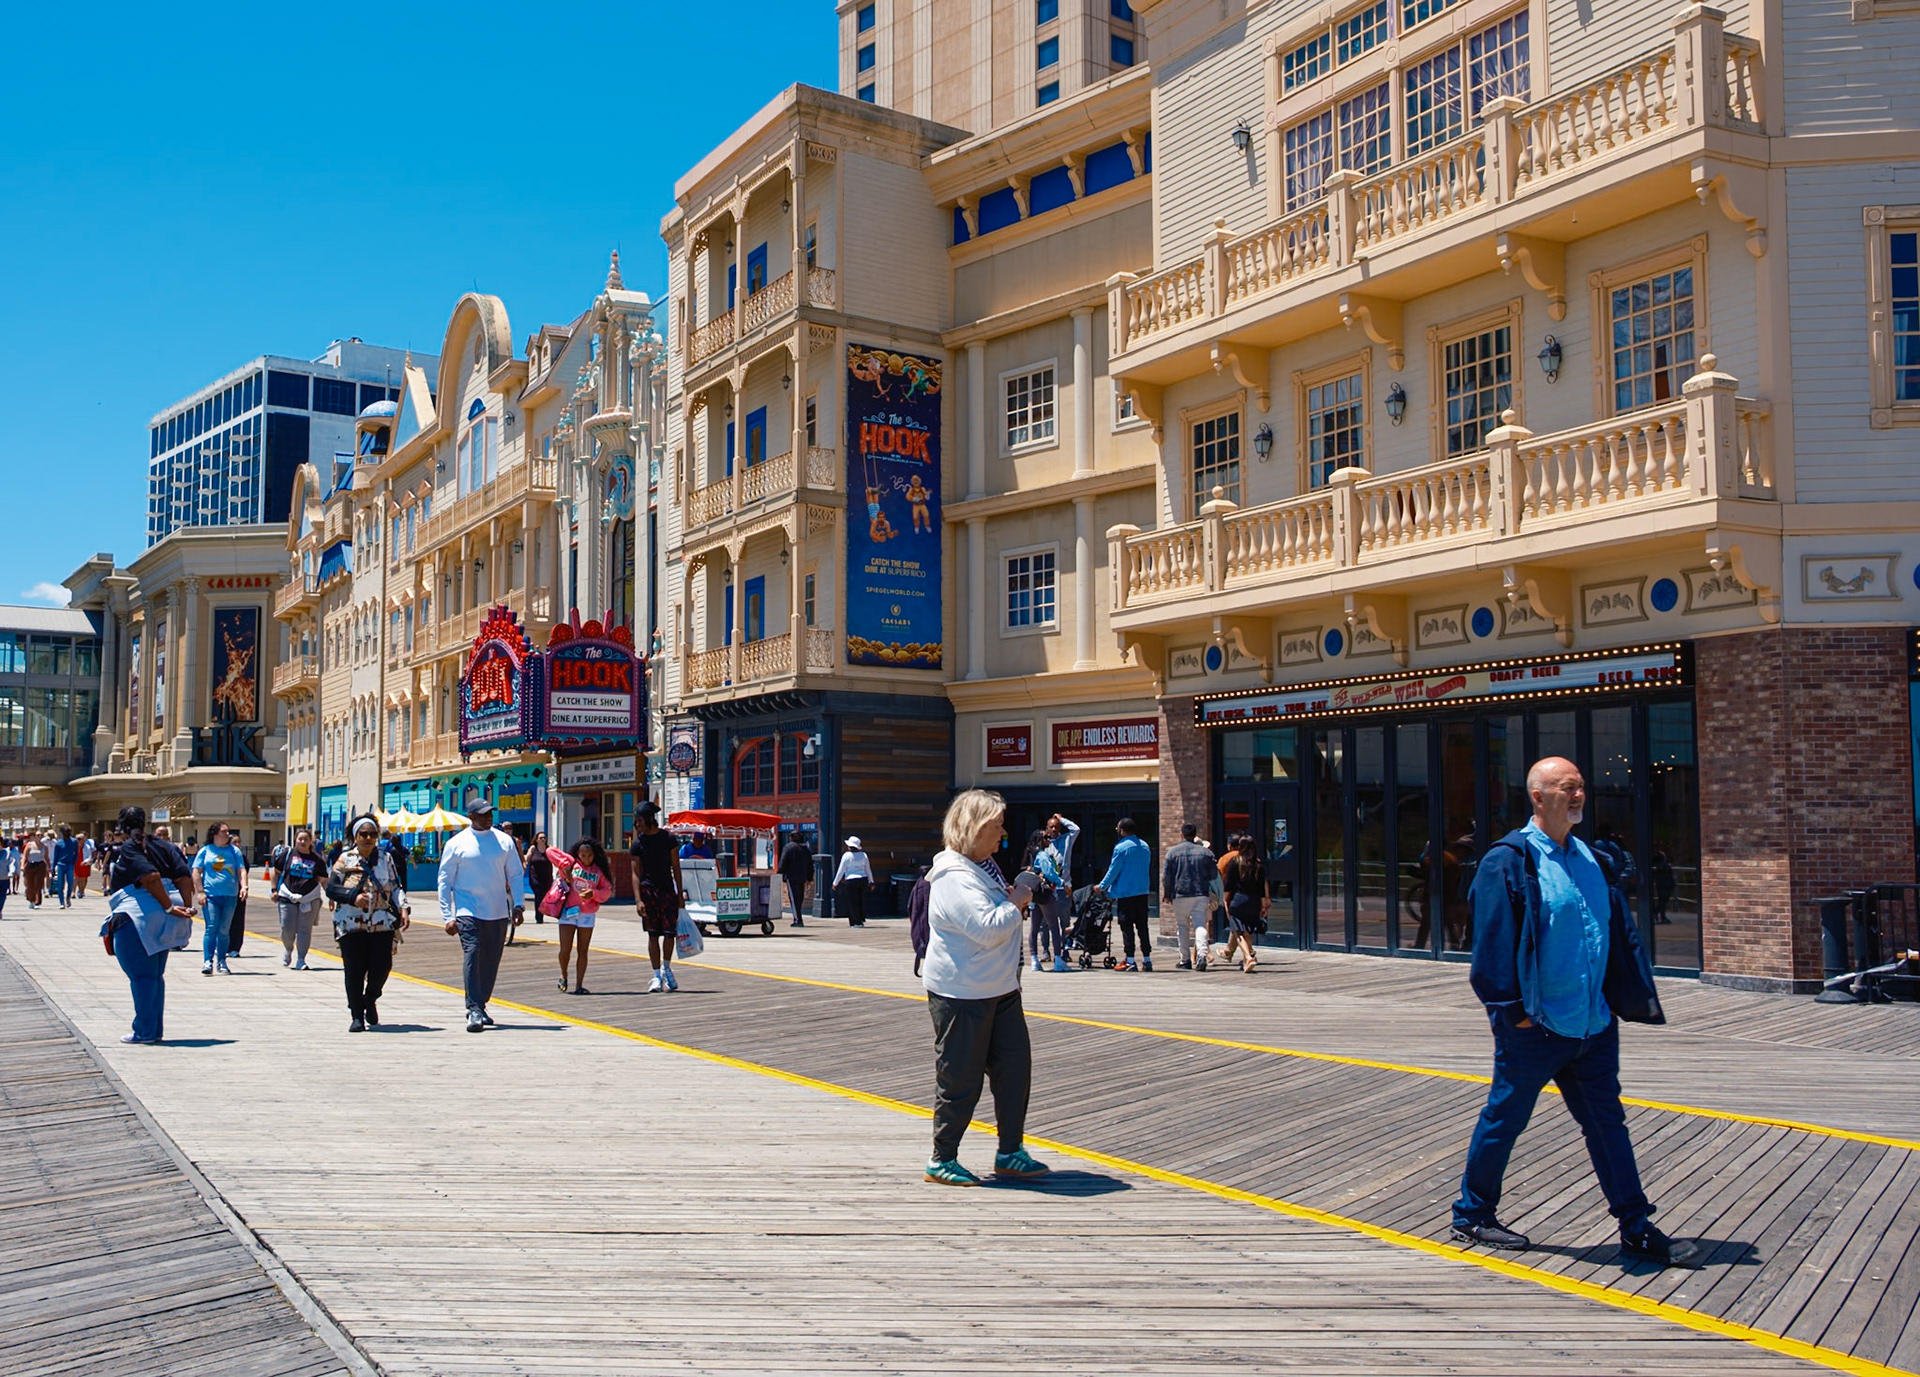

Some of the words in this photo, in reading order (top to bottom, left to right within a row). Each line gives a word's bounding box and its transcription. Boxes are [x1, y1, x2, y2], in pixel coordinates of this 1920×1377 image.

[888, 413, 902, 425] The
[860, 422, 932, 464] HOOK
[871, 557, 890, 567] CATCH
[891, 559, 901, 568] THE
[903, 560, 920, 569] SHOW
[865, 565, 878, 573] DINE
[880, 566, 886, 574] AT
[888, 567, 926, 578] SUPERFRICO
[208, 577, 271, 588] CAESARS
[866, 586, 925, 597] SPIEGELWORLD.COM
[881, 617, 911, 626] CAESARS
[585, 646, 603, 659] The
[552, 660, 632, 693] HOOK
[1490, 669, 1524, 682] DRAFT
[1532, 666, 1560, 678] BEER
[1598, 670, 1633, 683] BEER
[1394, 679, 1424, 703] WEST
[557, 697, 580, 705] CATCH
[583, 698, 598, 706] THE
[600, 698, 623, 706] SHOW
[1310, 700, 1328, 710] SAT
[552, 714, 570, 722] DINE
[572, 715, 582, 723] AT
[584, 716, 629, 724] SUPERFRICO
[991, 737, 1015, 745] CAESARS
[1058, 729, 1070, 748] ONE
[1083, 726, 1116, 746] ENDLESS
[1118, 724, 1158, 745] REWARDS.
[571, 867, 598, 883] MIAMI
[718, 888, 734, 899] OPEN
[735, 887, 749, 898] LATE
